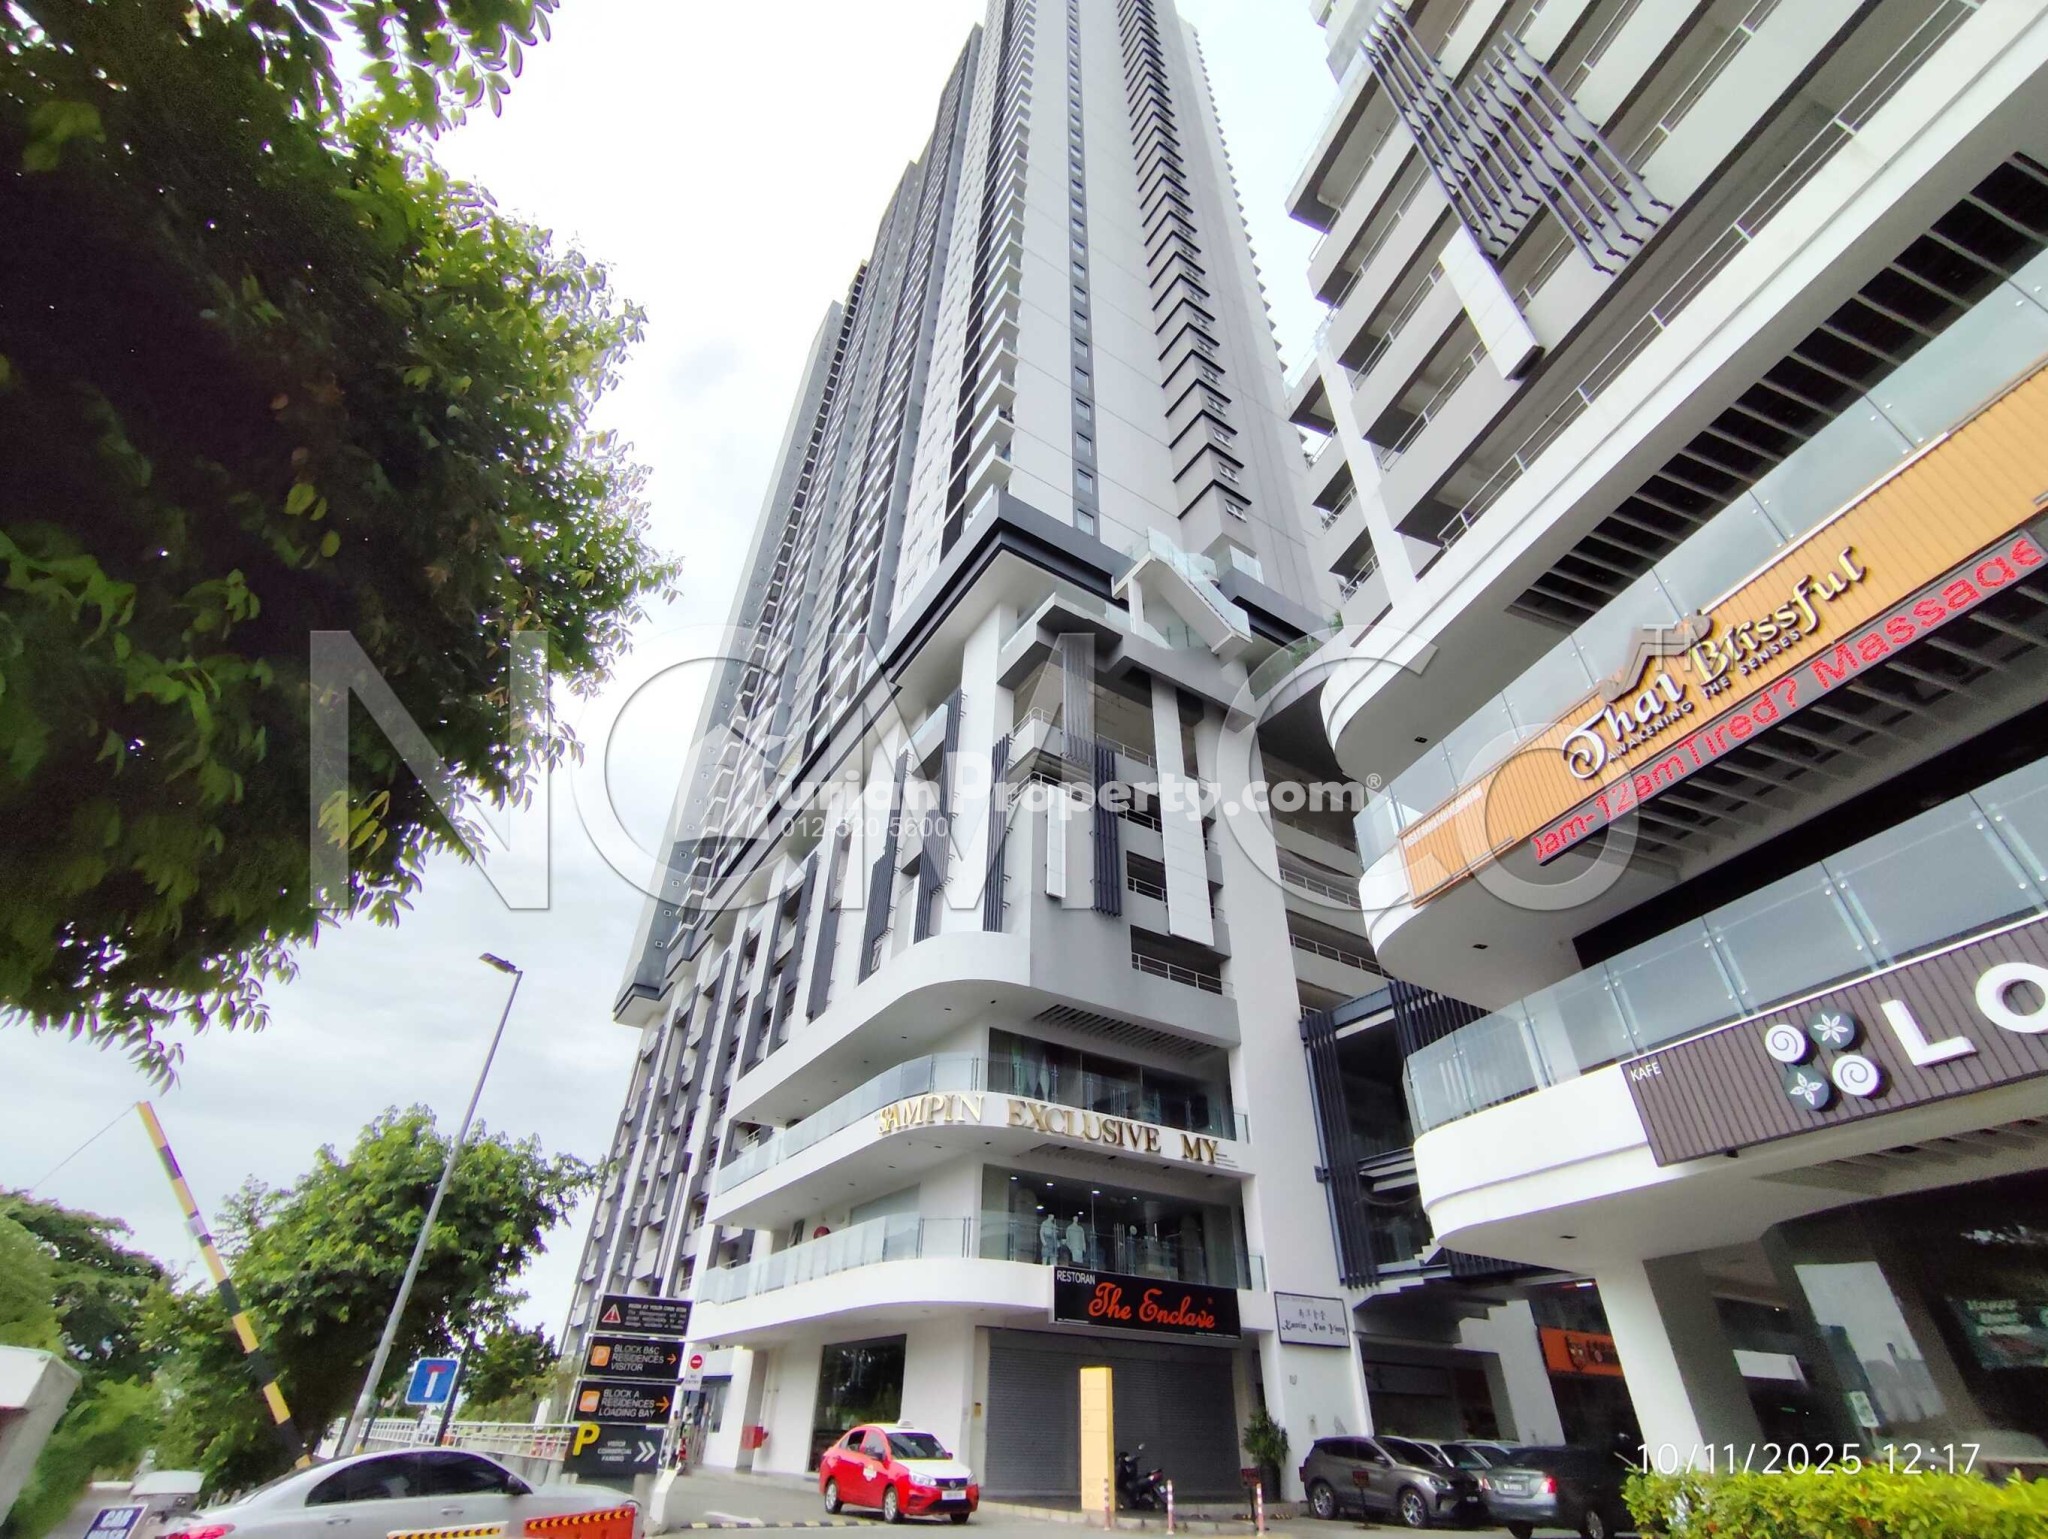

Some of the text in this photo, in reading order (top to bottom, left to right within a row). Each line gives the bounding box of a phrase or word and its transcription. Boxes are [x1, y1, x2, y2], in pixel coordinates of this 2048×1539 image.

[1562, 546, 1867, 779] Thai Blissful
[1606, 629, 1801, 762] AWAKENING THE SENSES
[1630, 1061, 1662, 1083] KAFE
[879, 1093, 1219, 1165] SAMPIN EXCLUSIVE MY
[1056, 1270, 1096, 1286] RESTORAN
[1088, 1282, 1216, 1329] The Enclave
[613, 1344, 660, 1355] BLOCK B&C
[611, 1353, 665, 1364] RESIDENCES
[611, 1362, 644, 1372] VISITOR
[603, 1388, 640, 1398] BLOCK A
[601, 1397, 655, 1408] RESIDENCES
[598, 1407, 656, 1418] LOADING BAY
[572, 1421, 601, 1456] P
[99, 1510, 134, 1528] CAR
